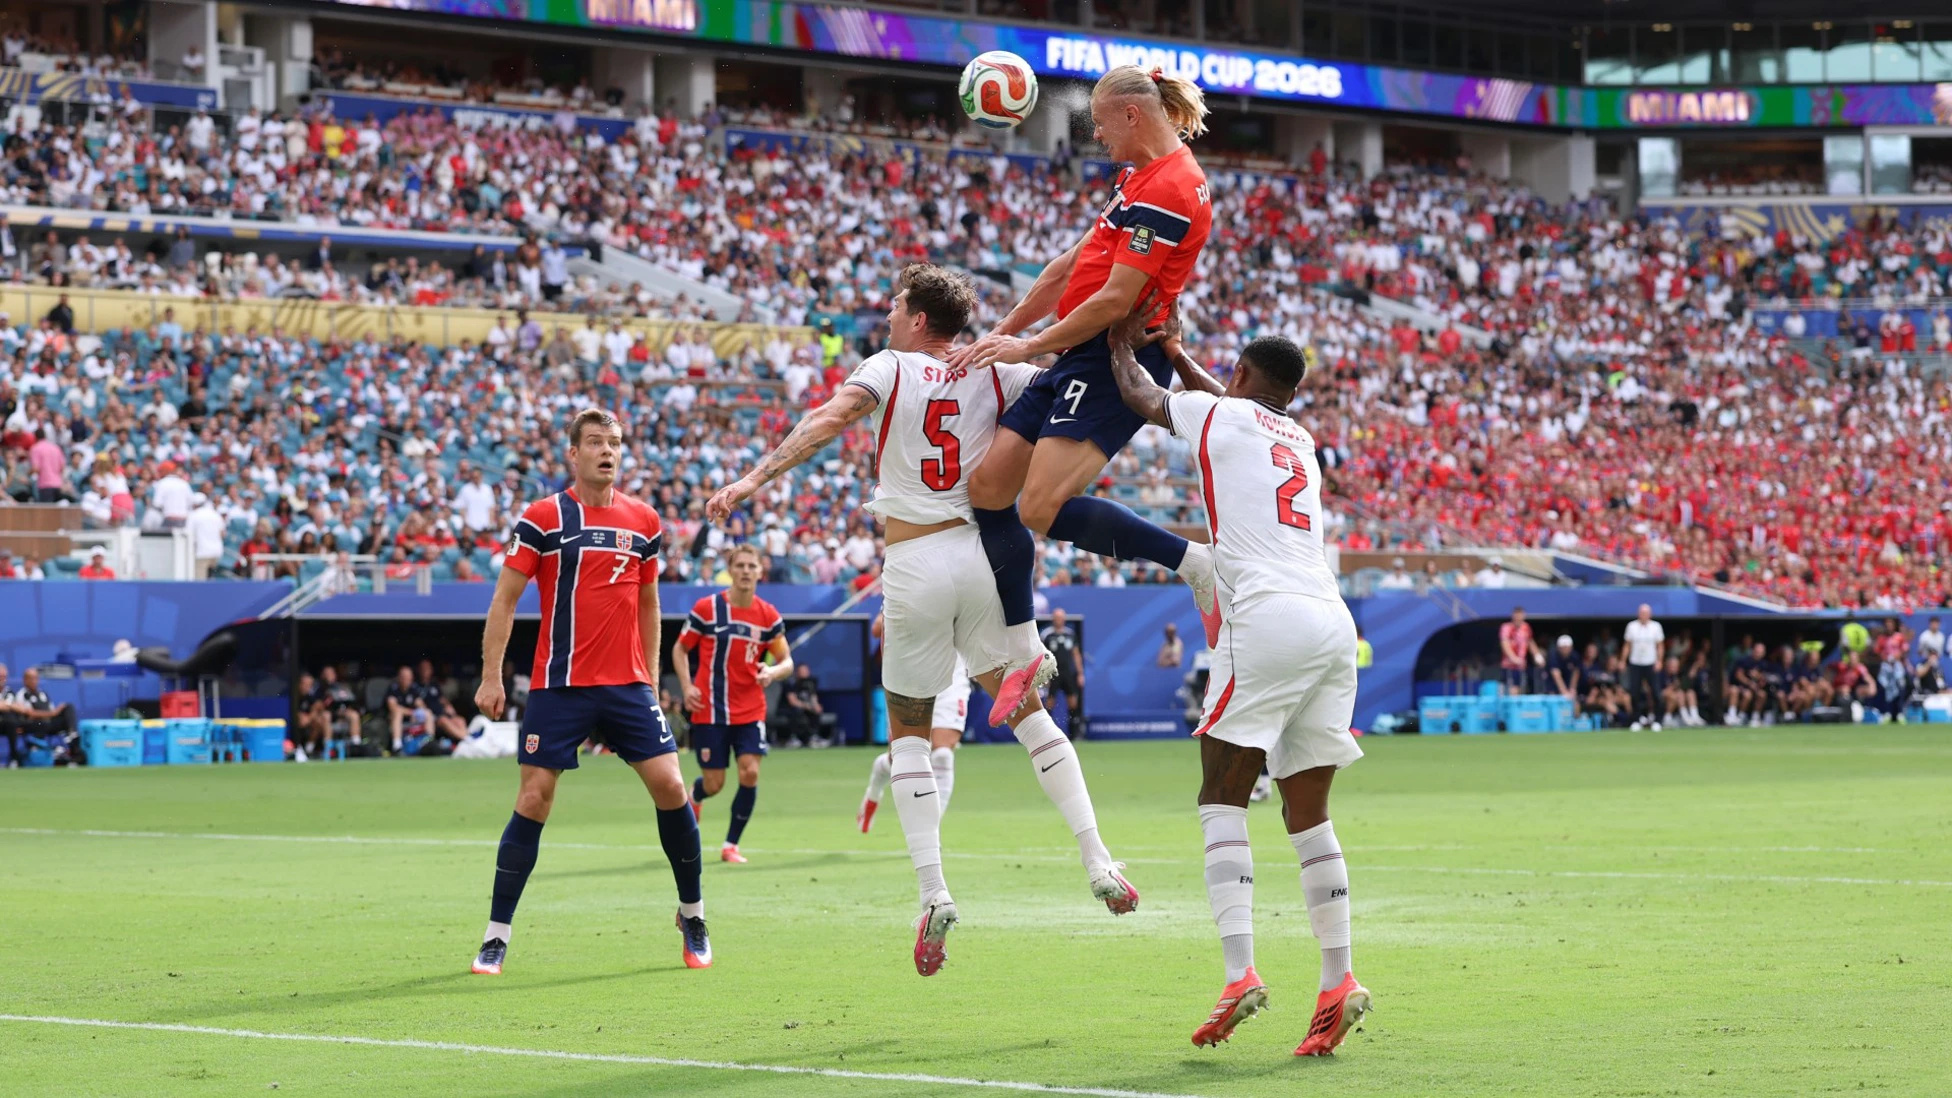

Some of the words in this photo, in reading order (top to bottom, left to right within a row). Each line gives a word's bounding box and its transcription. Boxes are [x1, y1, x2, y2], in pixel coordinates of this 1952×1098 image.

[587, 0, 695, 30] MIAMI
[1046, 36, 1105, 74] FIFA
[1104, 43, 1200, 82] WORLD
[1201, 53, 1254, 87] CUP
[1253, 60, 1343, 98] 2026
[1628, 91, 1749, 122] MIAMI
[1063, 378, 1089, 415] 9
[921, 398, 962, 492] 5
[1269, 442, 1311, 532] 2
[608, 554, 630, 584] 7
[650, 704, 667, 733] 7
